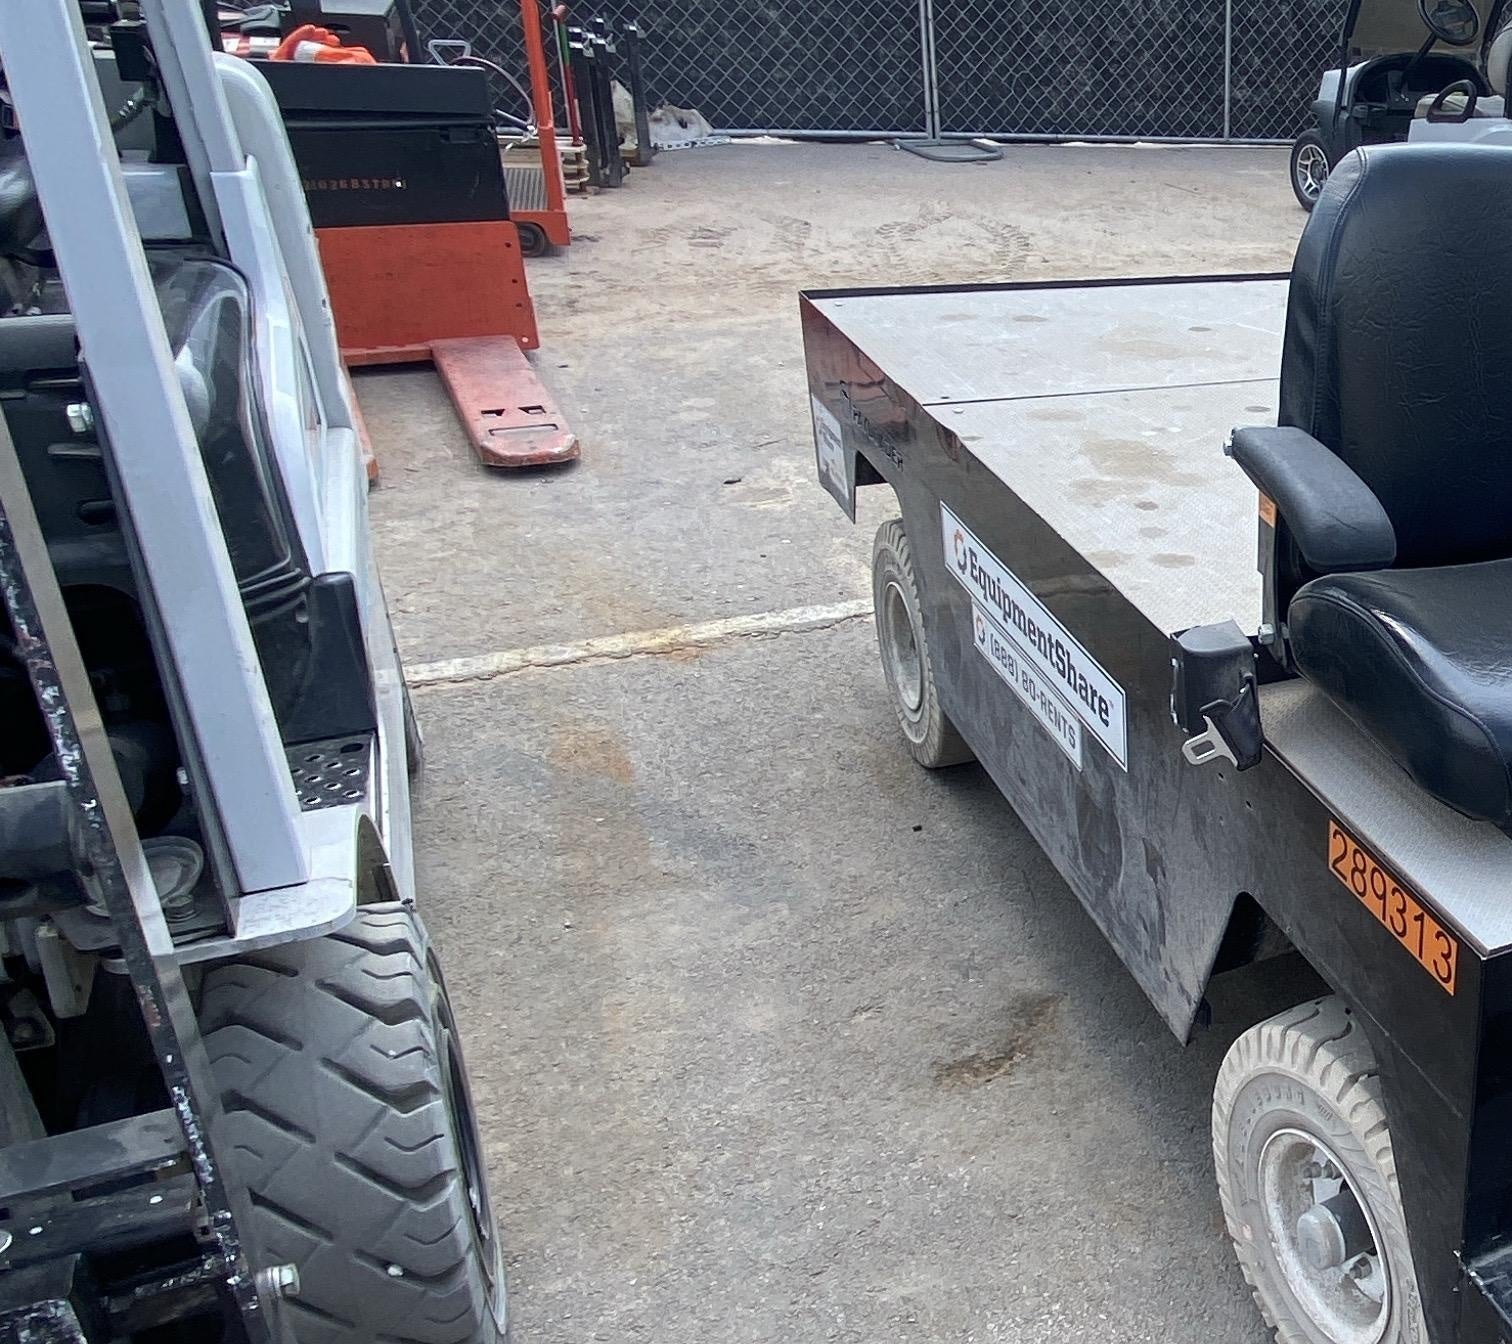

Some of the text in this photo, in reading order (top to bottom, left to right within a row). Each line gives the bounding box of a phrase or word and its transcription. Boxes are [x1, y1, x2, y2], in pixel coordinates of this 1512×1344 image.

[969, 546, 1111, 728] EquipmentShare
[990, 633, 1076, 750] (888) 80-RENTS
[1331, 828, 1453, 985] 289313
